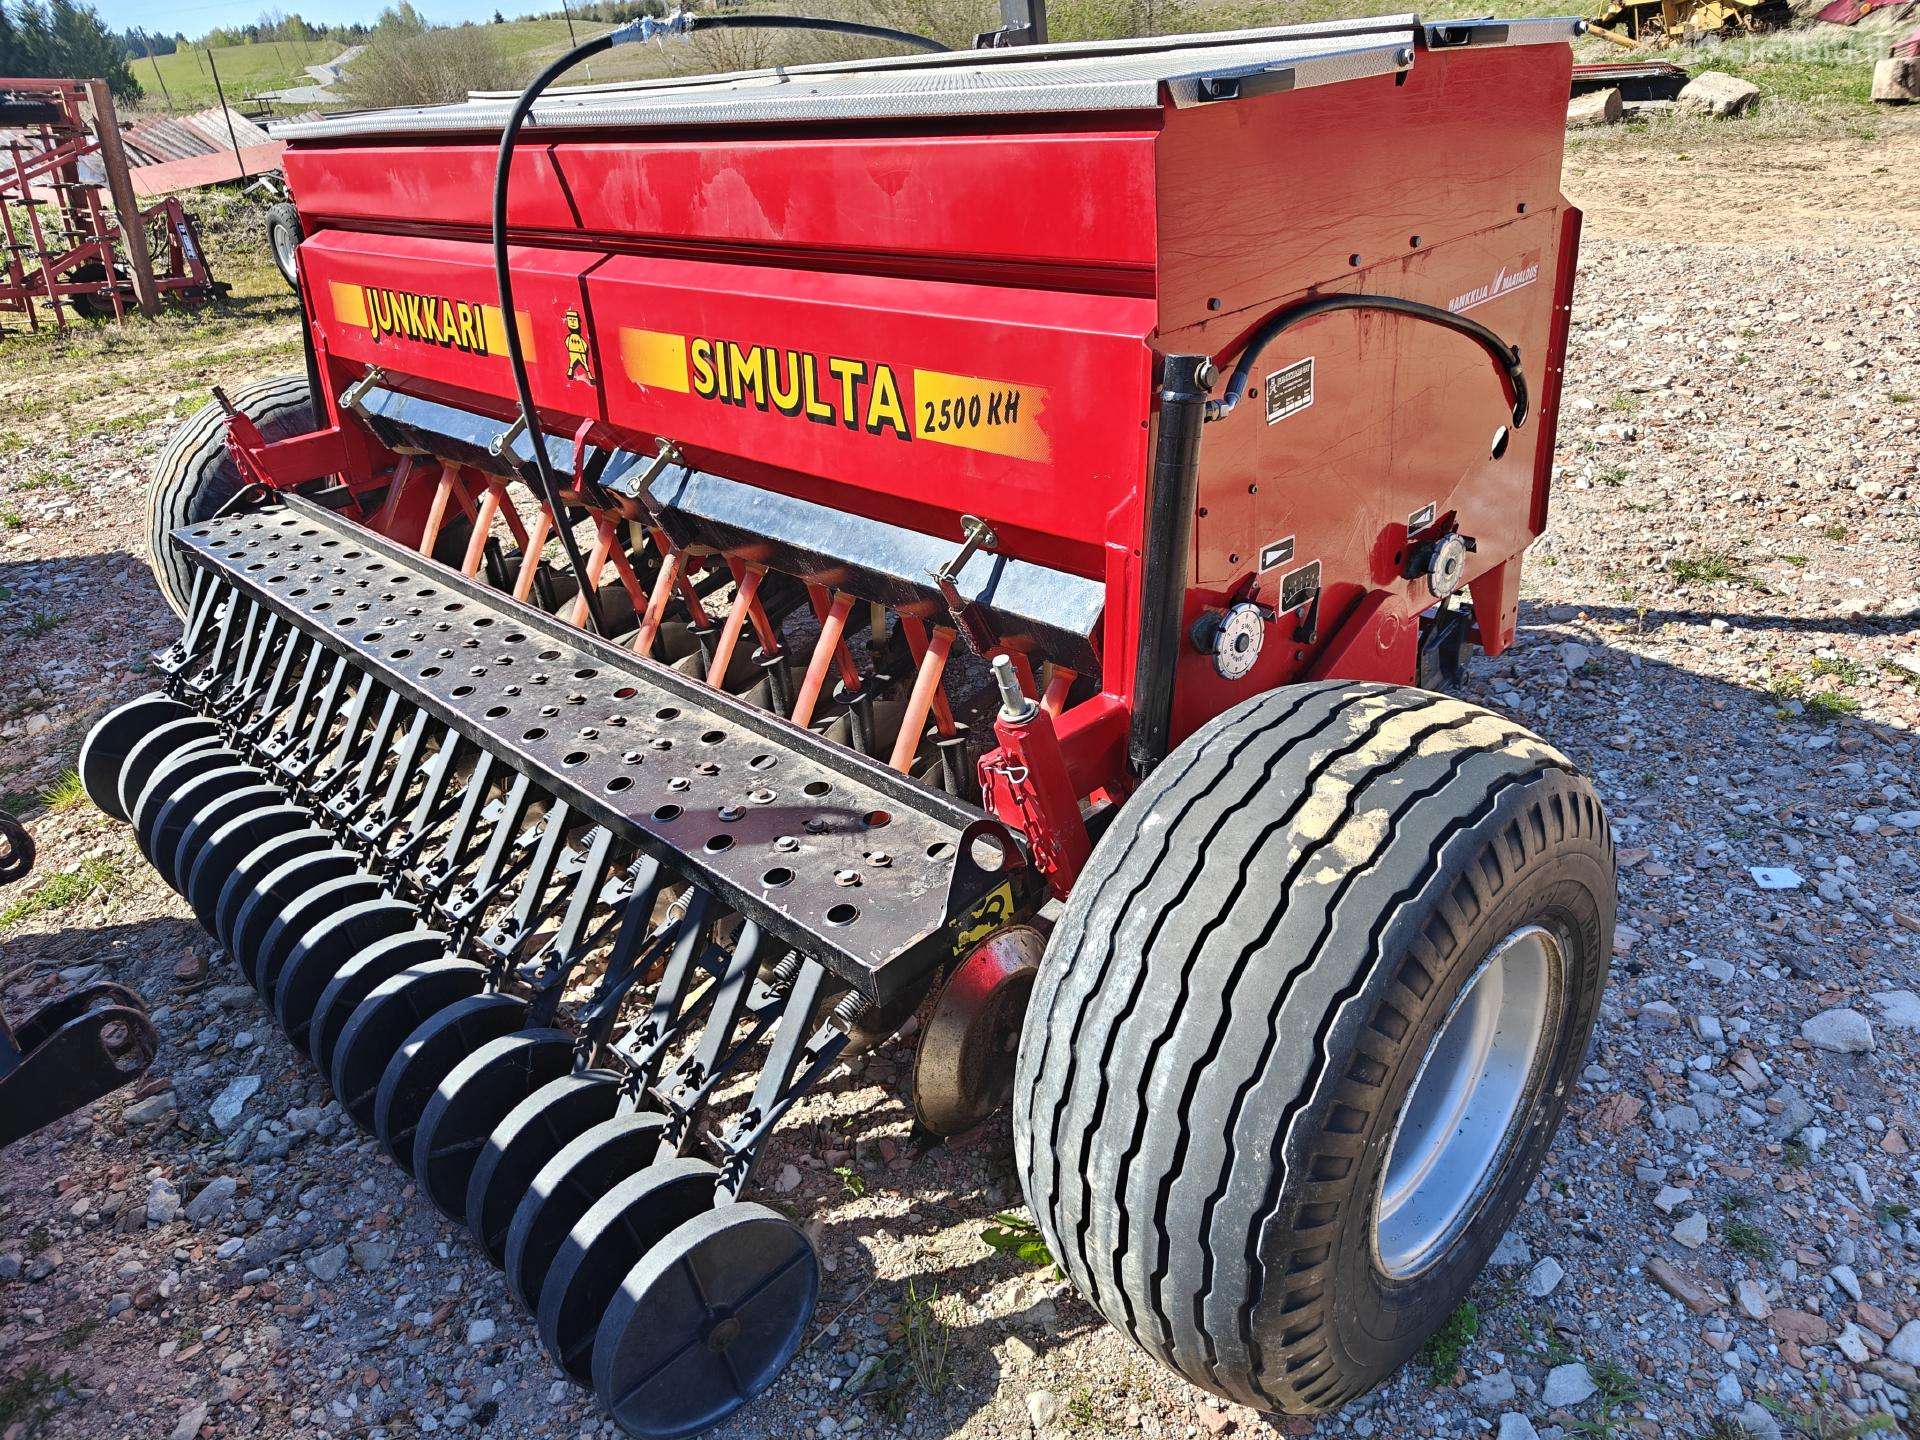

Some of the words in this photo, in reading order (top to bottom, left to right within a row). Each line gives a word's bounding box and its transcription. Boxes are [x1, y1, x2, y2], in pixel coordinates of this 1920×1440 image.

[366, 286, 488, 356] JUNKKARI
[1448, 284, 1488, 312] HANKKIJA
[690, 337, 912, 442] SIMULTA
[924, 394, 981, 433] 2500
[987, 391, 1020, 426] KH
